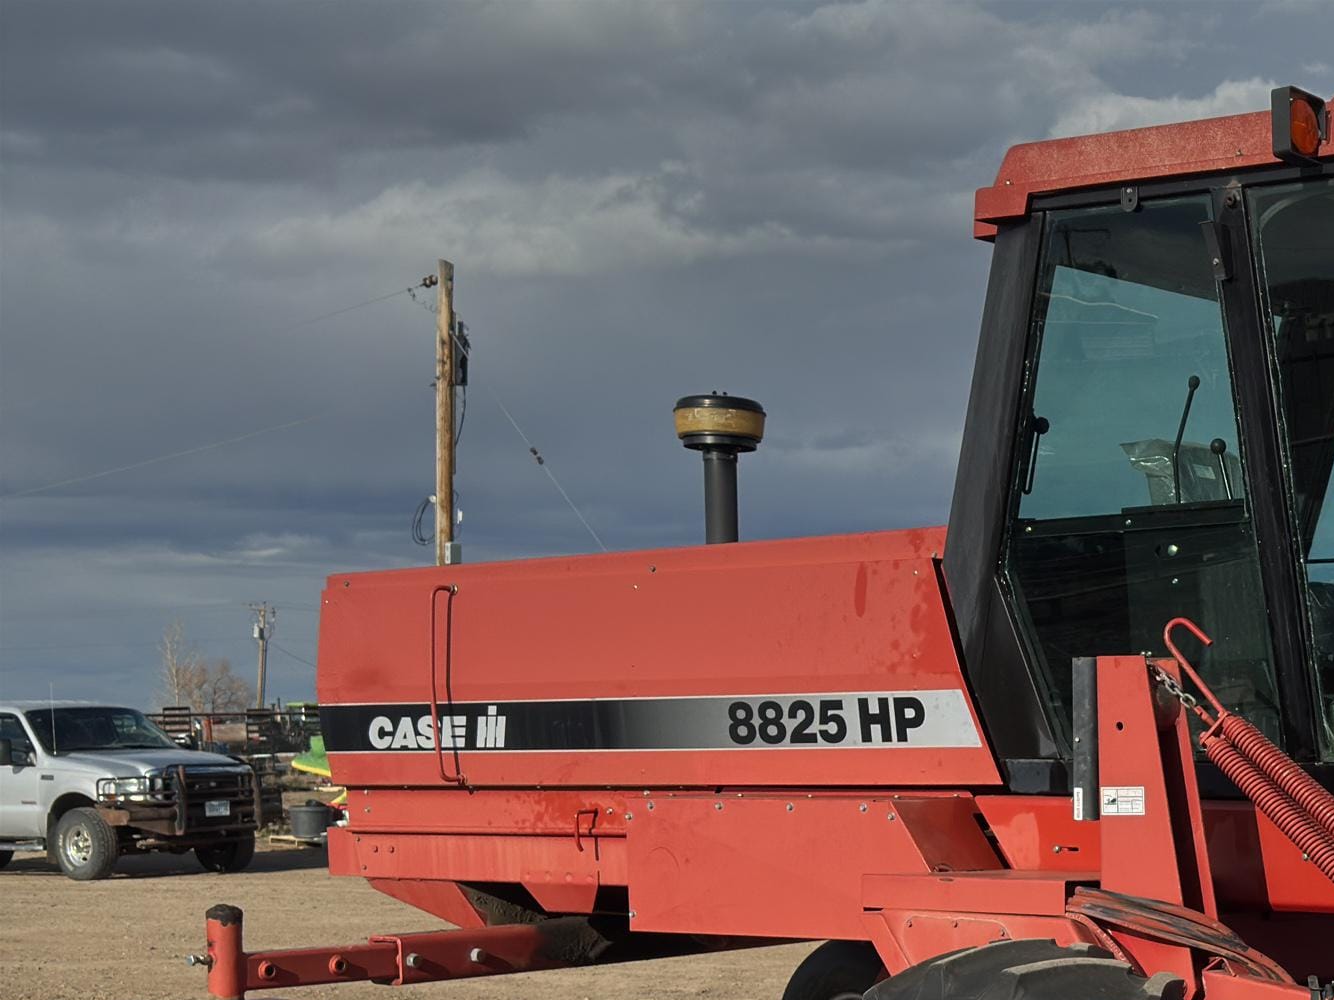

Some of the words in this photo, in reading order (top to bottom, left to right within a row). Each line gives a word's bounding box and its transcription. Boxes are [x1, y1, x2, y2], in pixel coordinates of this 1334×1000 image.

[368, 714, 467, 749] CASE
[728, 699, 848, 745] 8825
[857, 696, 926, 743] HP
